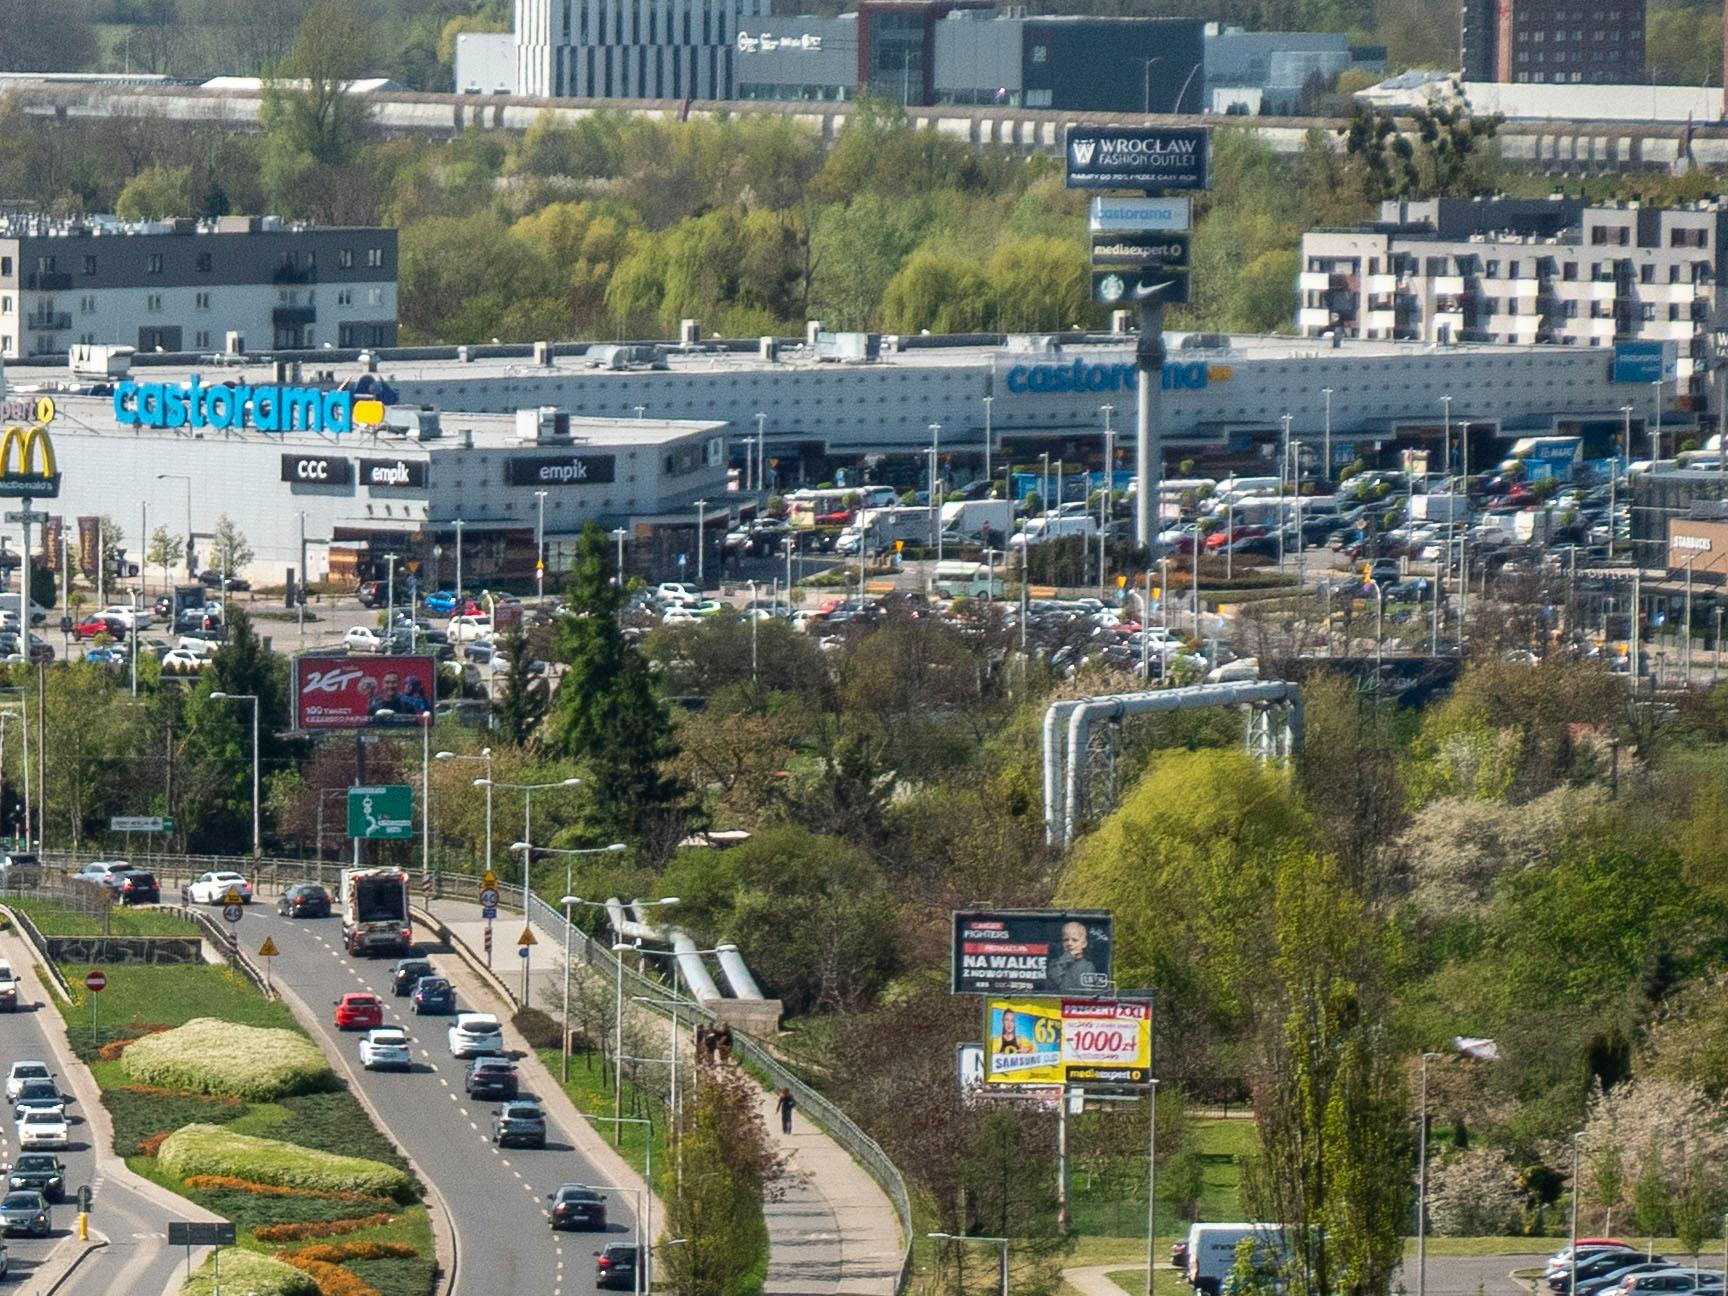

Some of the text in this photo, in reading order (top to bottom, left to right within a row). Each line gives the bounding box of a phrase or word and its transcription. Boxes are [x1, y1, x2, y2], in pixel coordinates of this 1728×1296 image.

[1100, 138, 1197, 154] WROCŁAW
[1098, 153, 1195, 167] FASHION OUTLET
[1098, 207, 1172, 221] castorama
[1094, 243, 1169, 257] mediaexpert
[113, 374, 353, 433] castorama
[297, 460, 328, 479] CCC
[371, 461, 410, 485] empik
[540, 458, 588, 484] empik
[1672, 534, 1713, 551] STARBUCKS
[302, 668, 364, 693] ZET
[963, 930, 1010, 939] FIGHTERS
[963, 955, 988, 968] NA
[962, 969, 1048, 980] Z NOWOTWOREM
[1118, 1005, 1143, 1018] XXL
[995, 1055, 1042, 1070] SAMSUNG
[1069, 1068, 1131, 1081] mediaexpert
